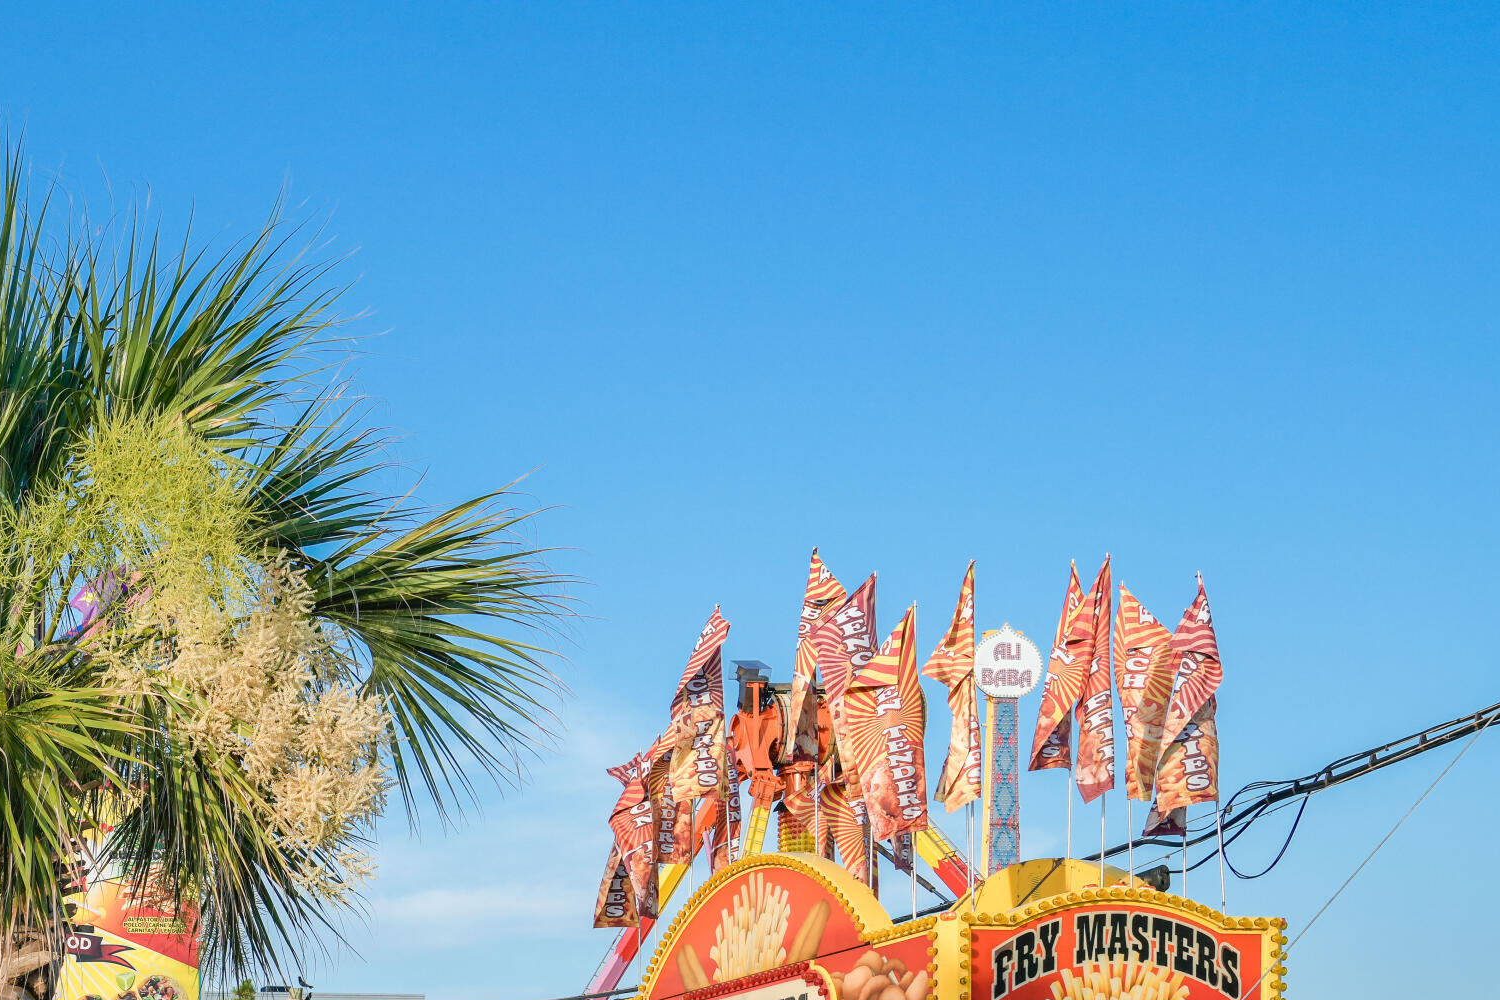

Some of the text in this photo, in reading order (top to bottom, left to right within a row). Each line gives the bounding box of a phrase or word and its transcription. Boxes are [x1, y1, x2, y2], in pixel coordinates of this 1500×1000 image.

[981, 667, 1032, 689] BABA
[992, 642, 1021, 661] ALI
[690, 719, 719, 788] FRIES
[881, 723, 924, 821] TENDERS
[1175, 722, 1212, 792] RIES
[604, 864, 629, 918] RIES
[66, 936, 92, 950] OD
